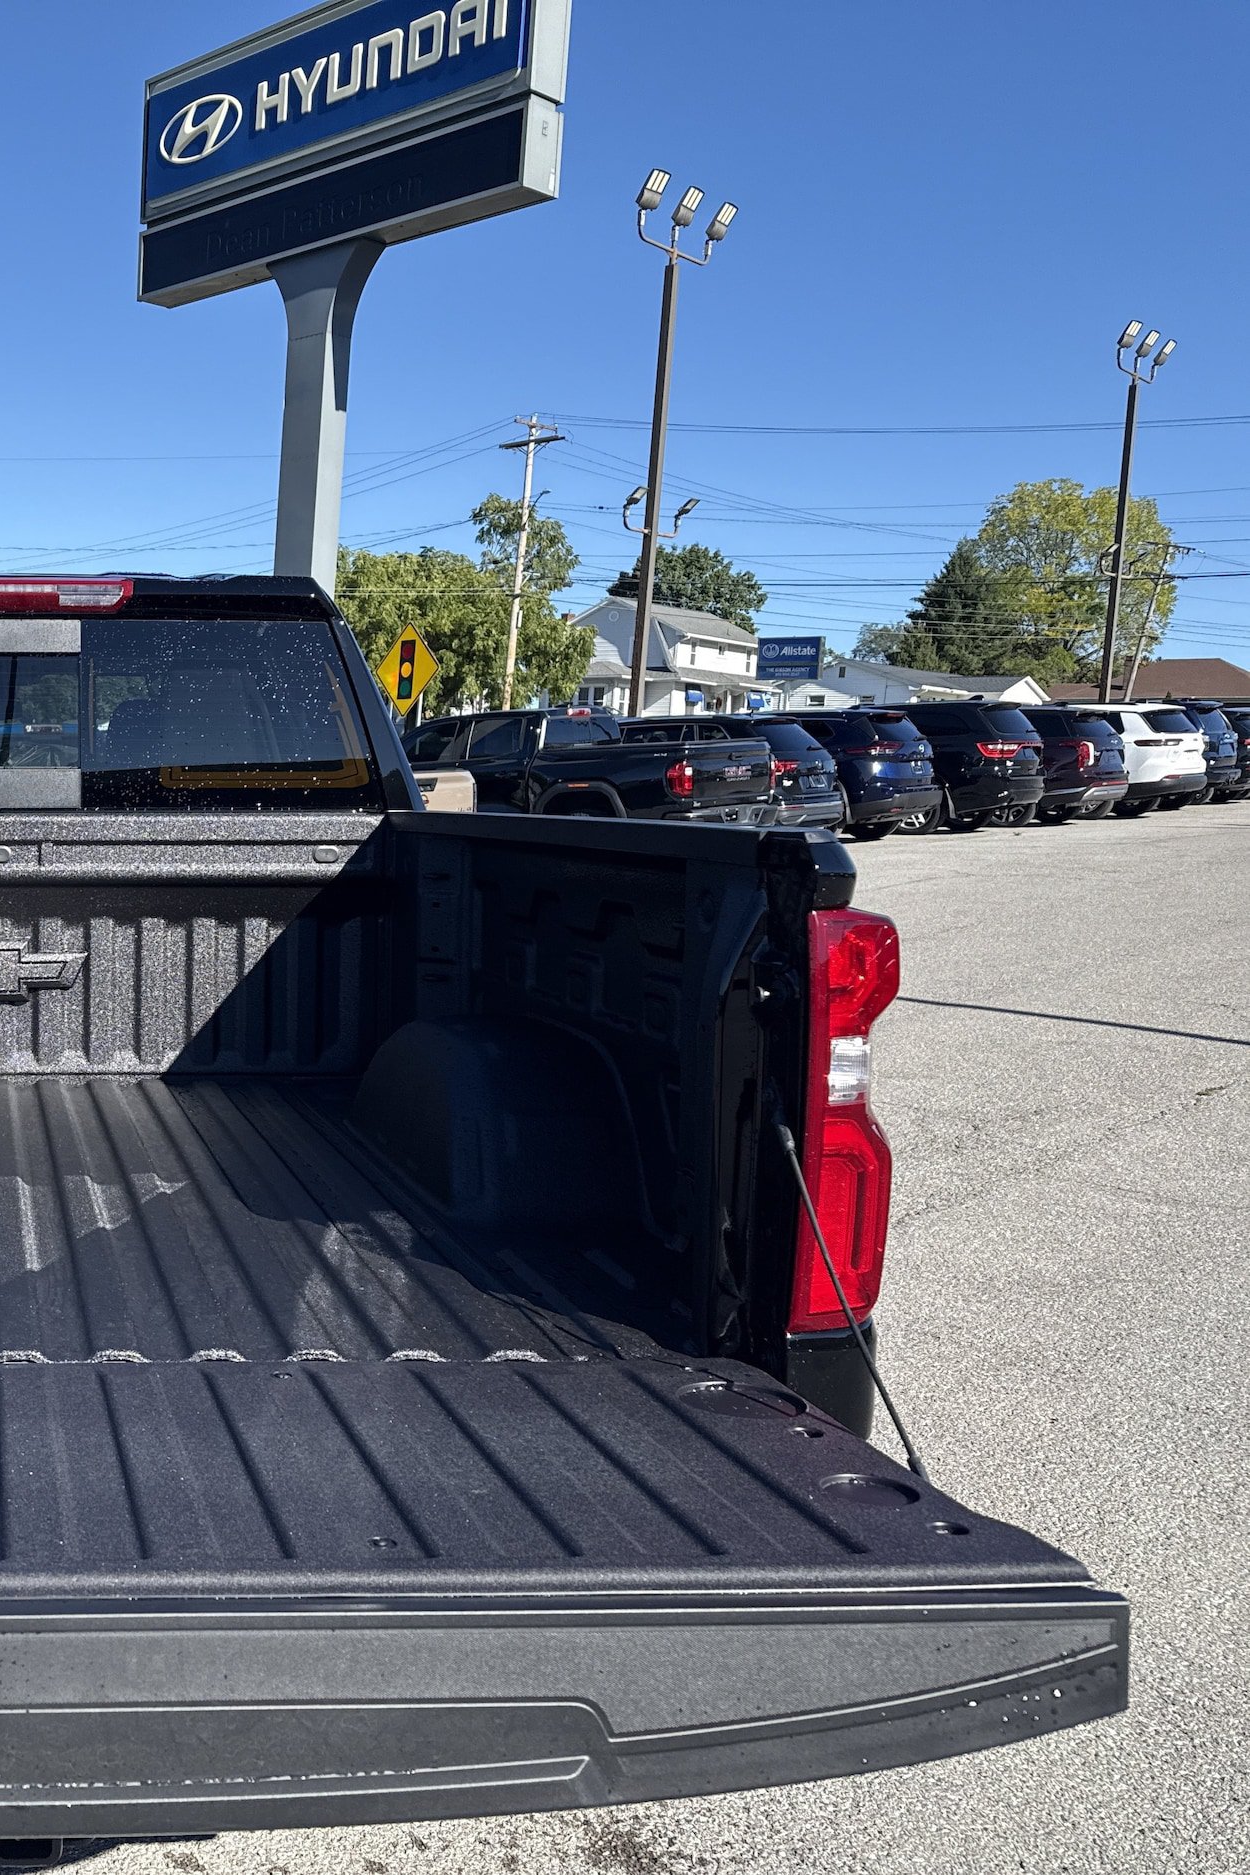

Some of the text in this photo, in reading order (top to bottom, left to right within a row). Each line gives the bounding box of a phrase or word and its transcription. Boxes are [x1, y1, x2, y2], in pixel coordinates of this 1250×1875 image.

[255, 0, 508, 131] HYUNDAI
[206, 174, 424, 265] Dean Patterson
[780, 645, 817, 656] Allstate
